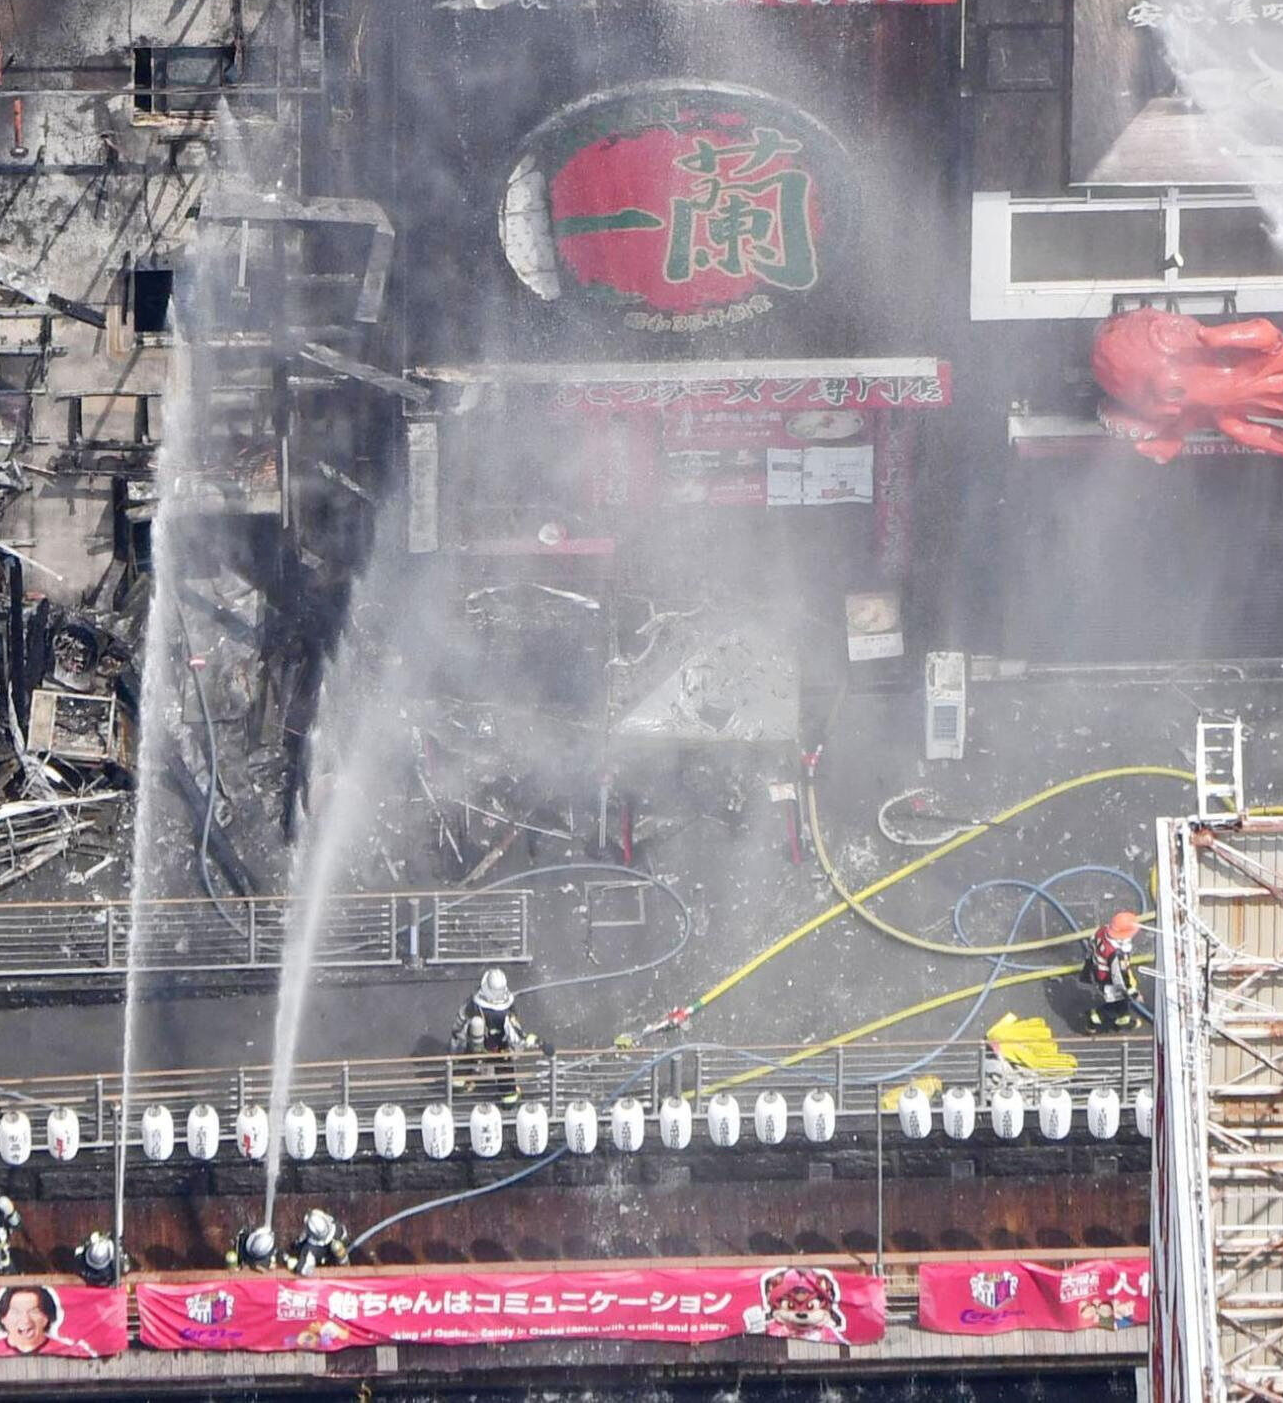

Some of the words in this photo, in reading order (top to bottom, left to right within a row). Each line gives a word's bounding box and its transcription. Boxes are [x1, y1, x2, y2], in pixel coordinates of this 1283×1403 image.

[553, 127, 819, 291] 一蘭
[328, 1289, 732, 1320] 飴ちゃんはコミュニケーション
